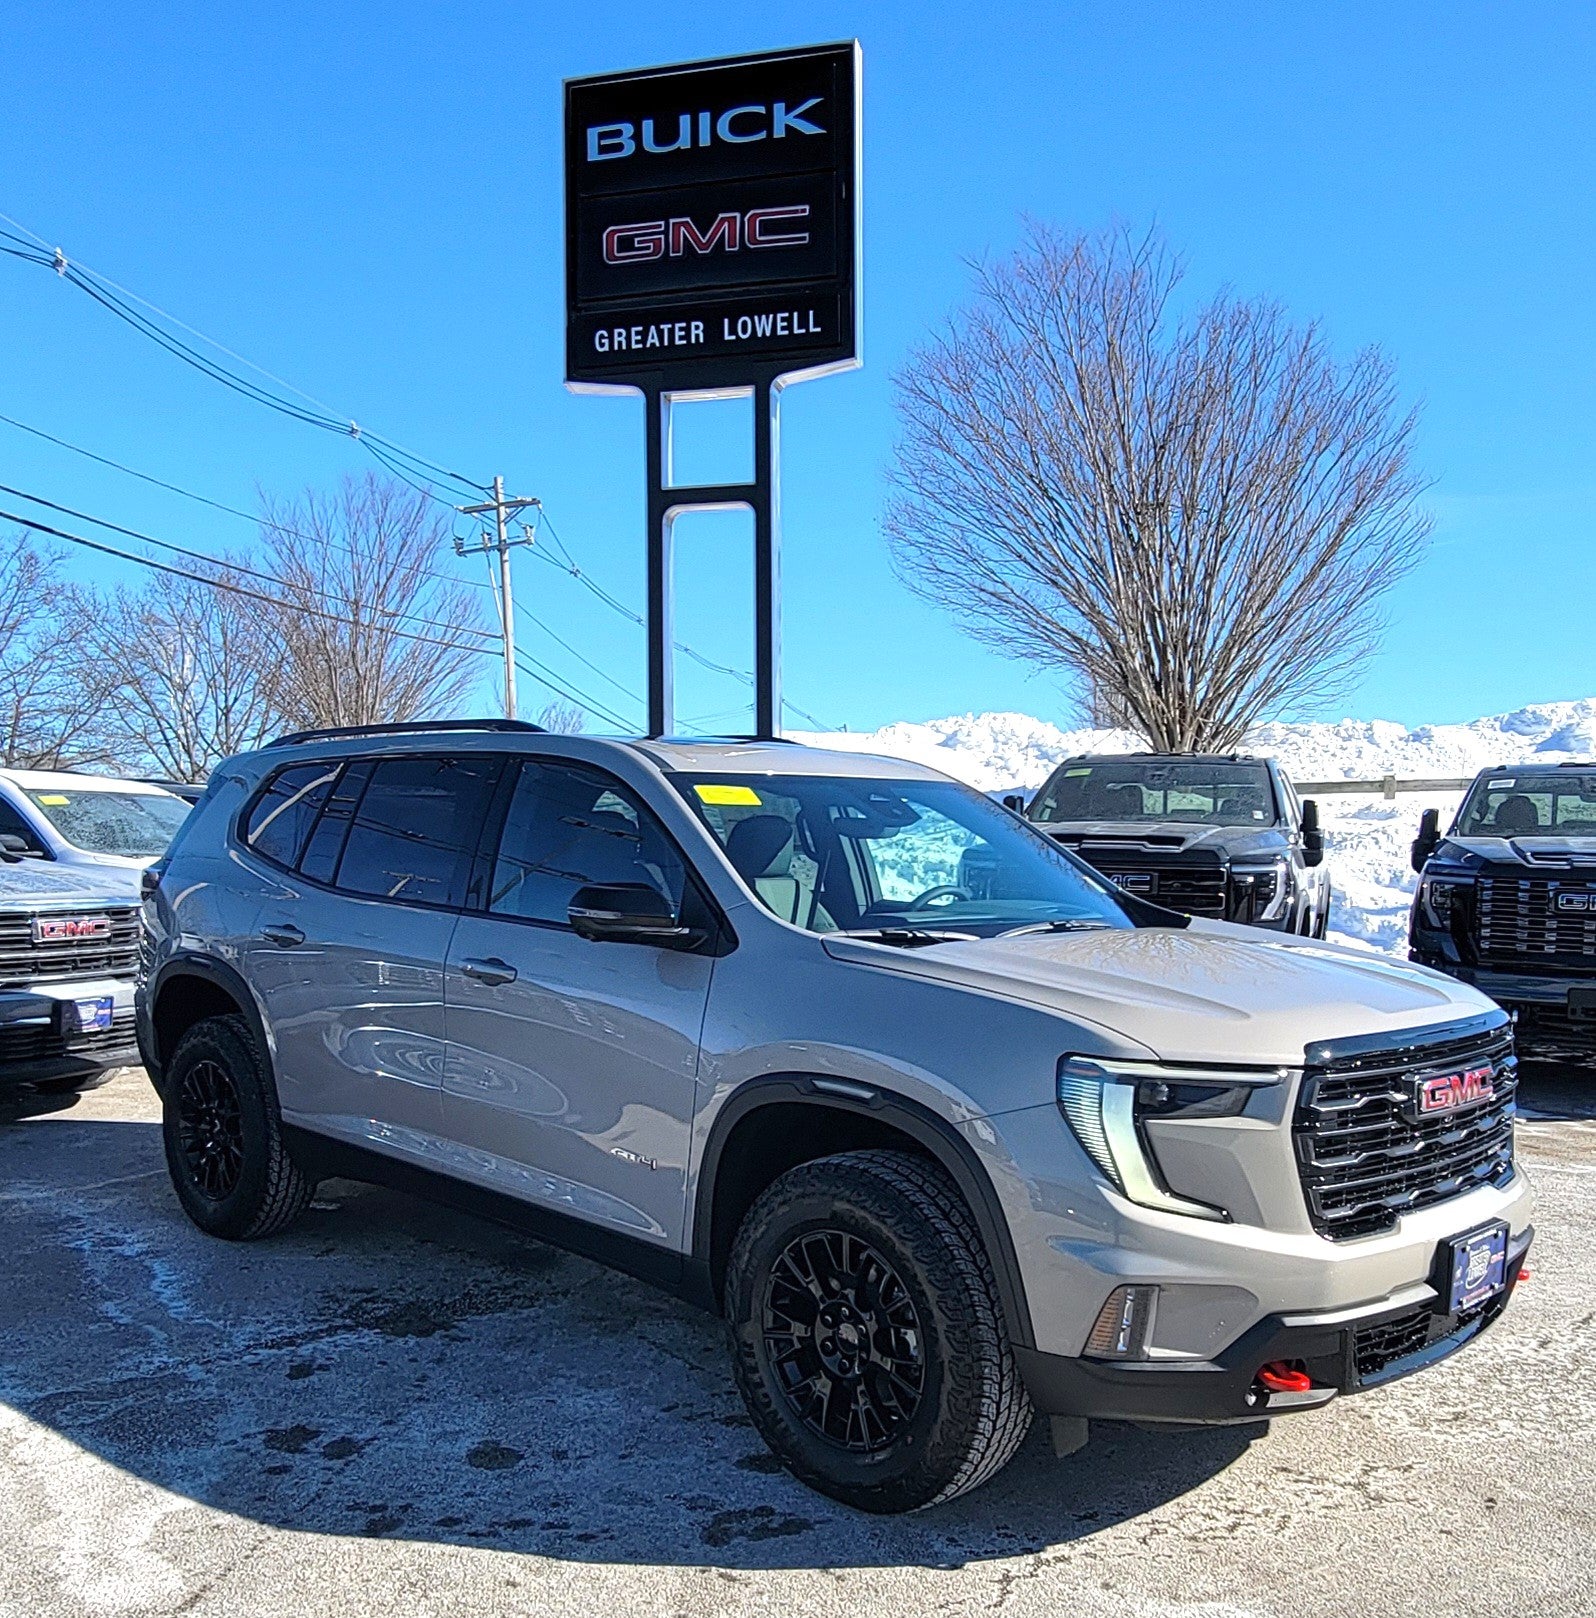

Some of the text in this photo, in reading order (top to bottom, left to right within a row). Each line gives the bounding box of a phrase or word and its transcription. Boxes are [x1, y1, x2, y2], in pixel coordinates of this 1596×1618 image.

[587, 98, 827, 161] BUICK
[603, 205, 809, 264] GMC
[594, 310, 821, 352] GREATER LOWELL
[43, 919, 109, 938] GMC
[1421, 1067, 1493, 1112] GMC
